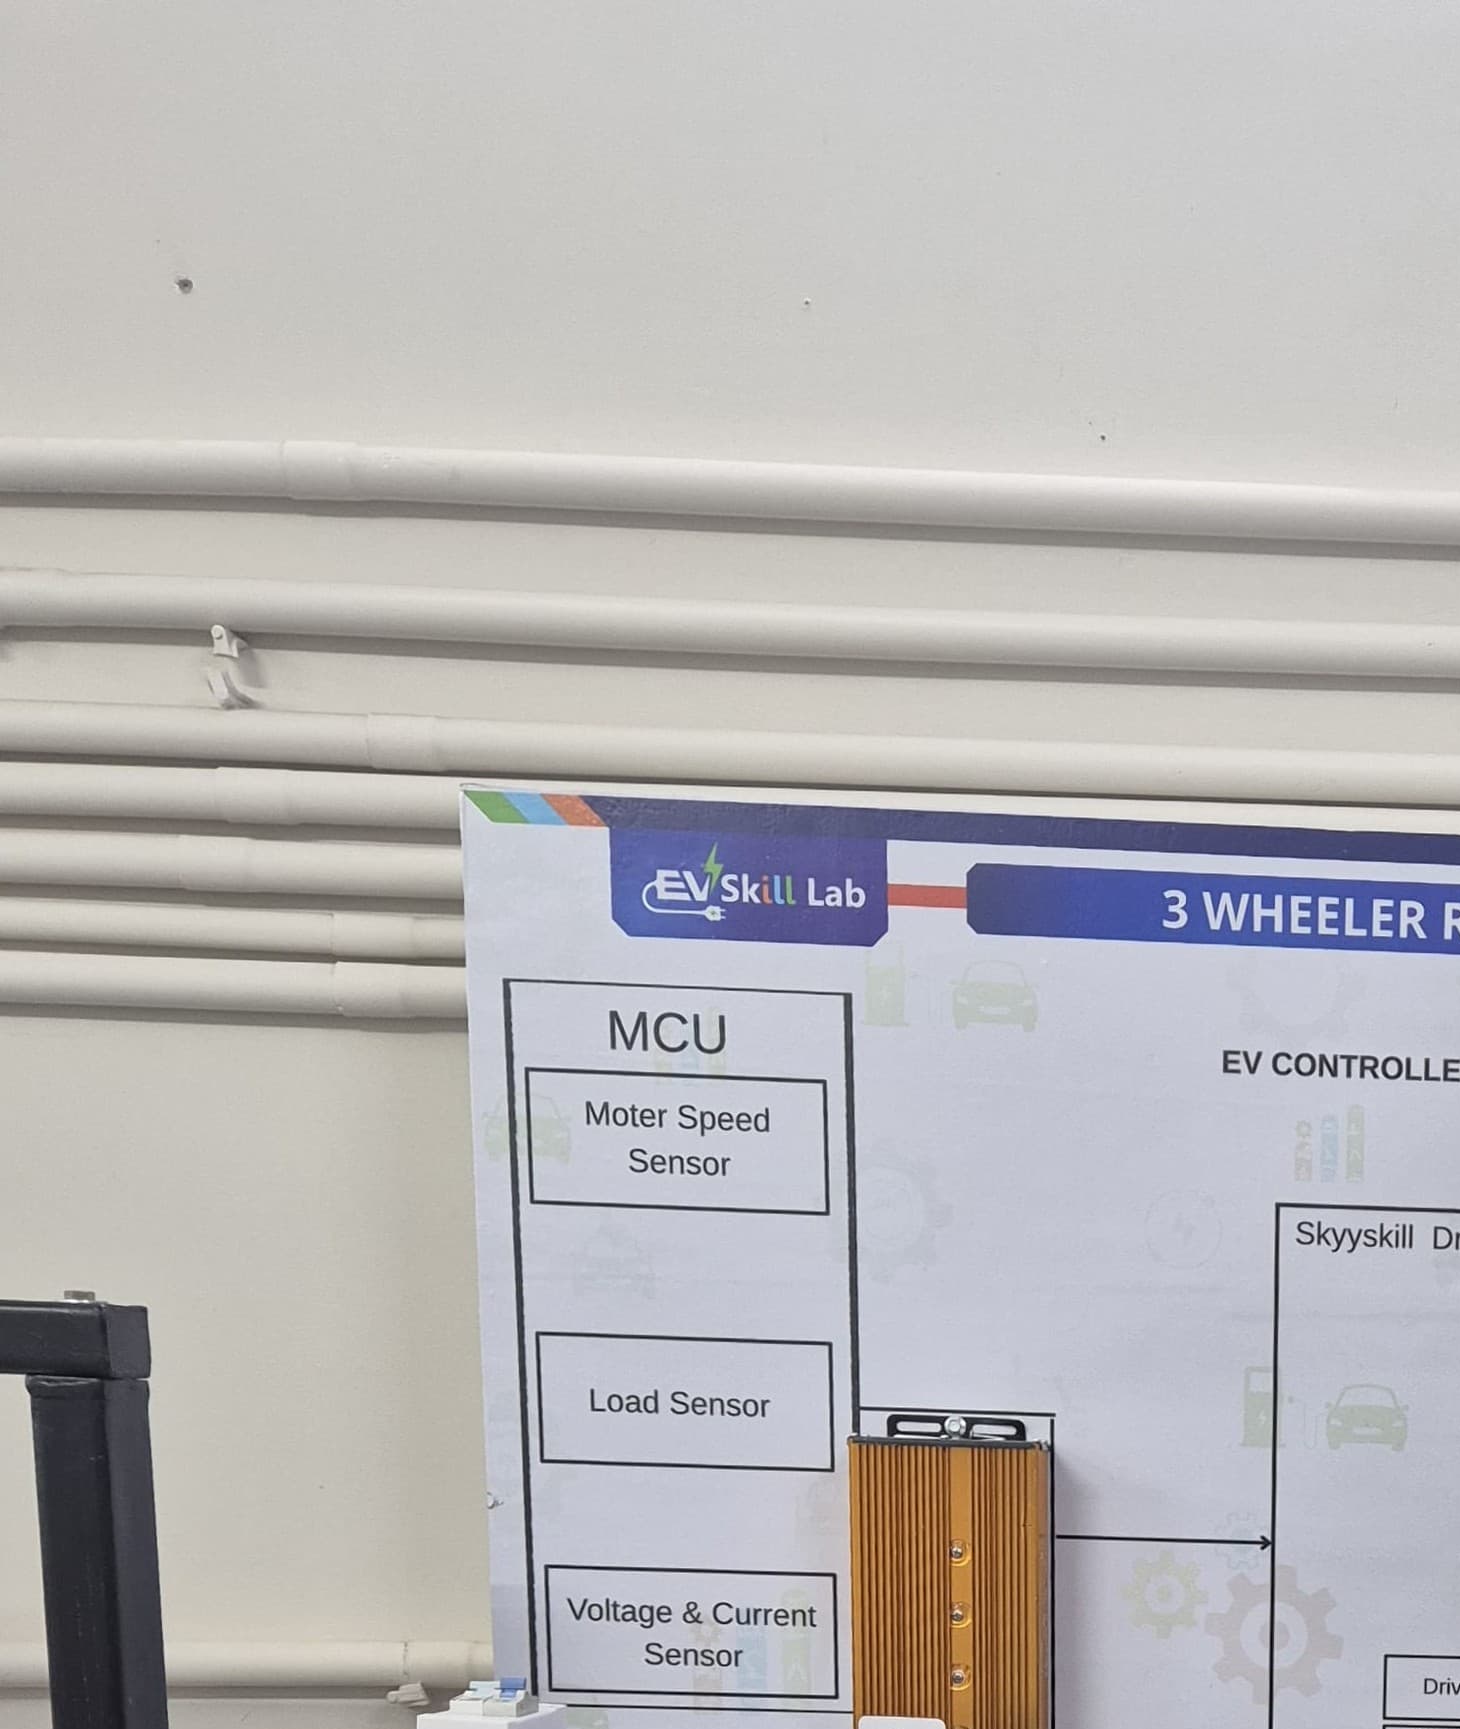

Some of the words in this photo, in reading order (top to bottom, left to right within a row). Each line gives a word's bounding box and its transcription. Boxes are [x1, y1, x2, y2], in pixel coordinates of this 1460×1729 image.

[720, 873, 797, 906] Skill
[807, 877, 866, 909] Lab
[1162, 889, 1188, 930] 3
[1202, 891, 1428, 941] WHEELER
[608, 1009, 728, 1055] MCU
[1221, 1049, 1262, 1075] EV
[585, 1100, 667, 1130] Moter
[676, 1104, 771, 1135] Speed
[628, 1148, 731, 1178] Sensor
[1295, 1220, 1414, 1252] Skyyskill
[589, 1387, 660, 1416] Load
[669, 1389, 770, 1419] Sensor
[566, 1596, 673, 1631] Voltage
[681, 1601, 704, 1627] &
[712, 1601, 818, 1629] Current
[644, 1641, 744, 1669] Sensor
